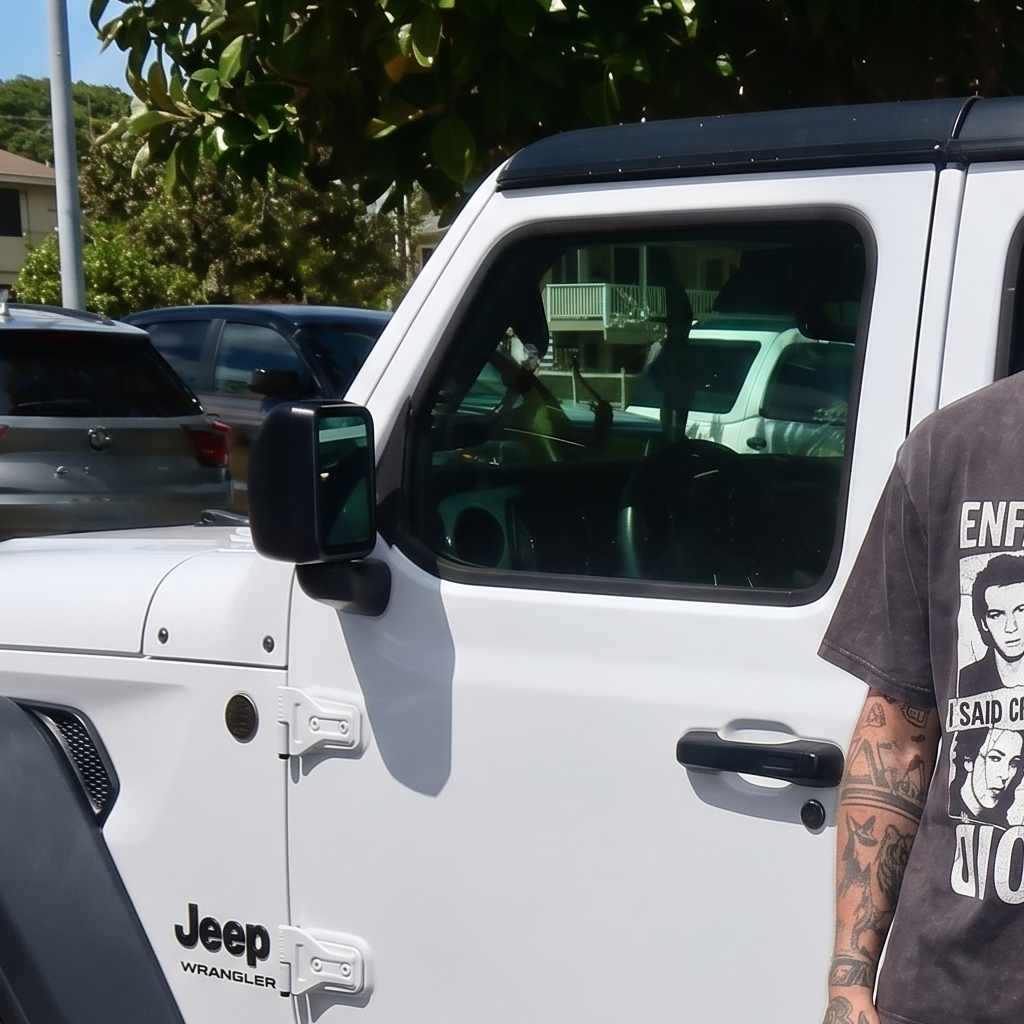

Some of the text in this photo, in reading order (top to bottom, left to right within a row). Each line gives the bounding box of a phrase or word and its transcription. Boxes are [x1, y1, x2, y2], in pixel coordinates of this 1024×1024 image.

[949, 702, 954, 728] I
[959, 700, 1003, 727] SAID
[174, 902, 271, 969] Jeep
[180, 961, 277, 989] WRANGLER
